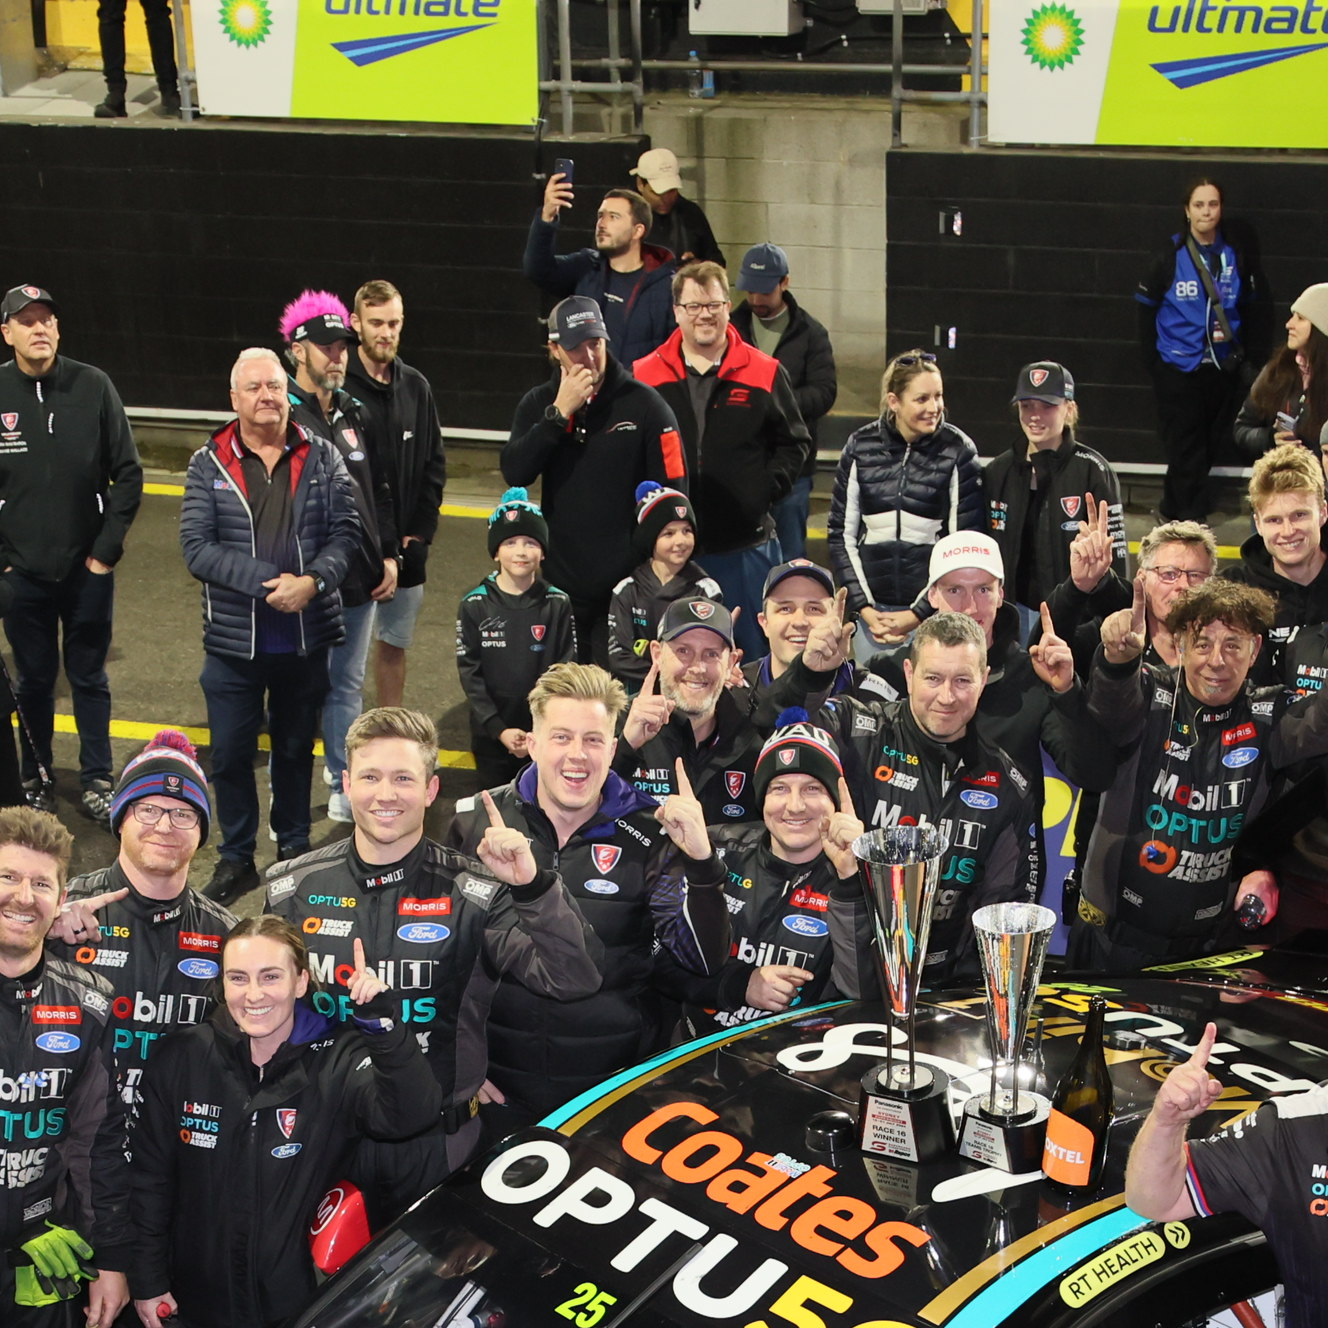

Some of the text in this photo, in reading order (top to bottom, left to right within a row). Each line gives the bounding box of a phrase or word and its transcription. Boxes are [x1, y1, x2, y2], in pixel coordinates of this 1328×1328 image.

[1176, 281, 1198, 297] 86
[566, 311, 595, 322] LANCASTER
[1075, 451, 1106, 472] MORRIS
[942, 546, 992, 560] MORRIS
[481, 640, 507, 648] OPTUS
[1297, 664, 1321, 678] Mobil
[1251, 703, 1273, 713] OMP
[634, 781, 670, 793] OPTUS
[1152, 768, 1220, 811] Mobil
[967, 792, 991, 807] Ford
[1145, 803, 1245, 845] OPTUS
[1178, 849, 1233, 868] TRUCK
[1168, 862, 1229, 884] ASSIST
[270, 878, 295, 893] OMP
[366, 873, 393, 888] Mobil
[465, 879, 491, 897] OMP
[308, 894, 357, 908] OPTU5G
[403, 902, 447, 912] MORRIS
[321, 918, 354, 930] TRUCK
[318, 926, 353, 938] ASSIST
[408, 924, 439, 940] Ford
[183, 937, 219, 949] MORRIS
[96, 948, 130, 960] TRUCK
[36, 1010, 77, 1020] MORRIS
[45, 1034, 72, 1049] Ford
[874, 1099, 903, 1110] Panasonic
[180, 1116, 219, 1133] OPTUS
[872, 1124, 895, 1135] RACE
[189, 1140, 217, 1149] ASSIST
[191, 1132, 218, 1143] TRUCK
[873, 1133, 907, 1145] WINNER
[622, 1101, 931, 1279] Coates
[1068, 1235, 1158, 1302] RT HEALTH
